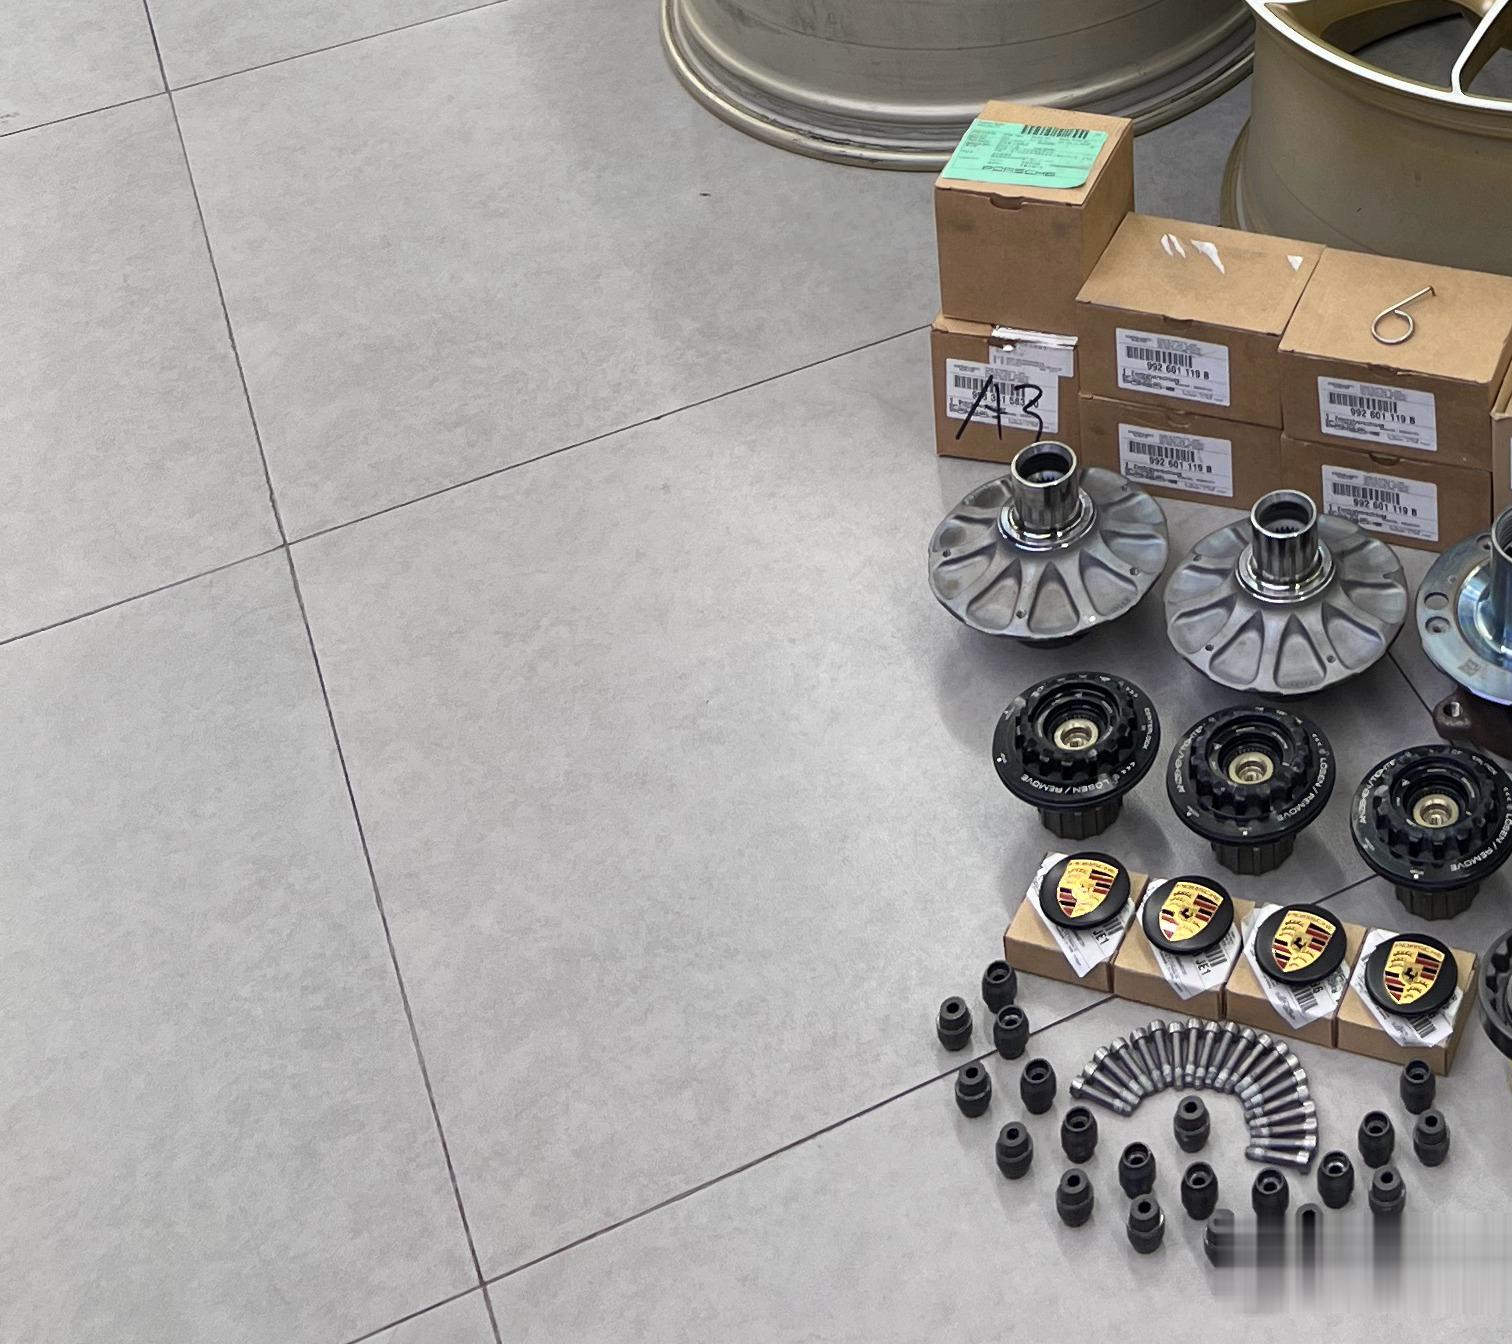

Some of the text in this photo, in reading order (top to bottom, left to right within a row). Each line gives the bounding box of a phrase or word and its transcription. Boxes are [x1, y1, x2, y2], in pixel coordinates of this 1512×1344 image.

[1146, 361, 1163, 372] 992
[1165, 364, 1182, 374] 601
[1186, 368, 1201, 379] 119
[955, 374, 1044, 443] A3
[1350, 407, 1367, 418] 992
[1370, 410, 1386, 420] 601
[1391, 414, 1406, 424] 119
[1149, 456, 1165, 467] 992
[1168, 459, 1184, 469] 601
[1188, 463, 1203, 473] 119
[1353, 497, 1370, 509] 992
[1373, 501, 1388, 512] 601
[1393, 505, 1408, 515] 119
[1020, 773, 1063, 794] REMOVE
[1276, 791, 1317, 822] REMOVE
[1450, 847, 1494, 872] REMOVE
